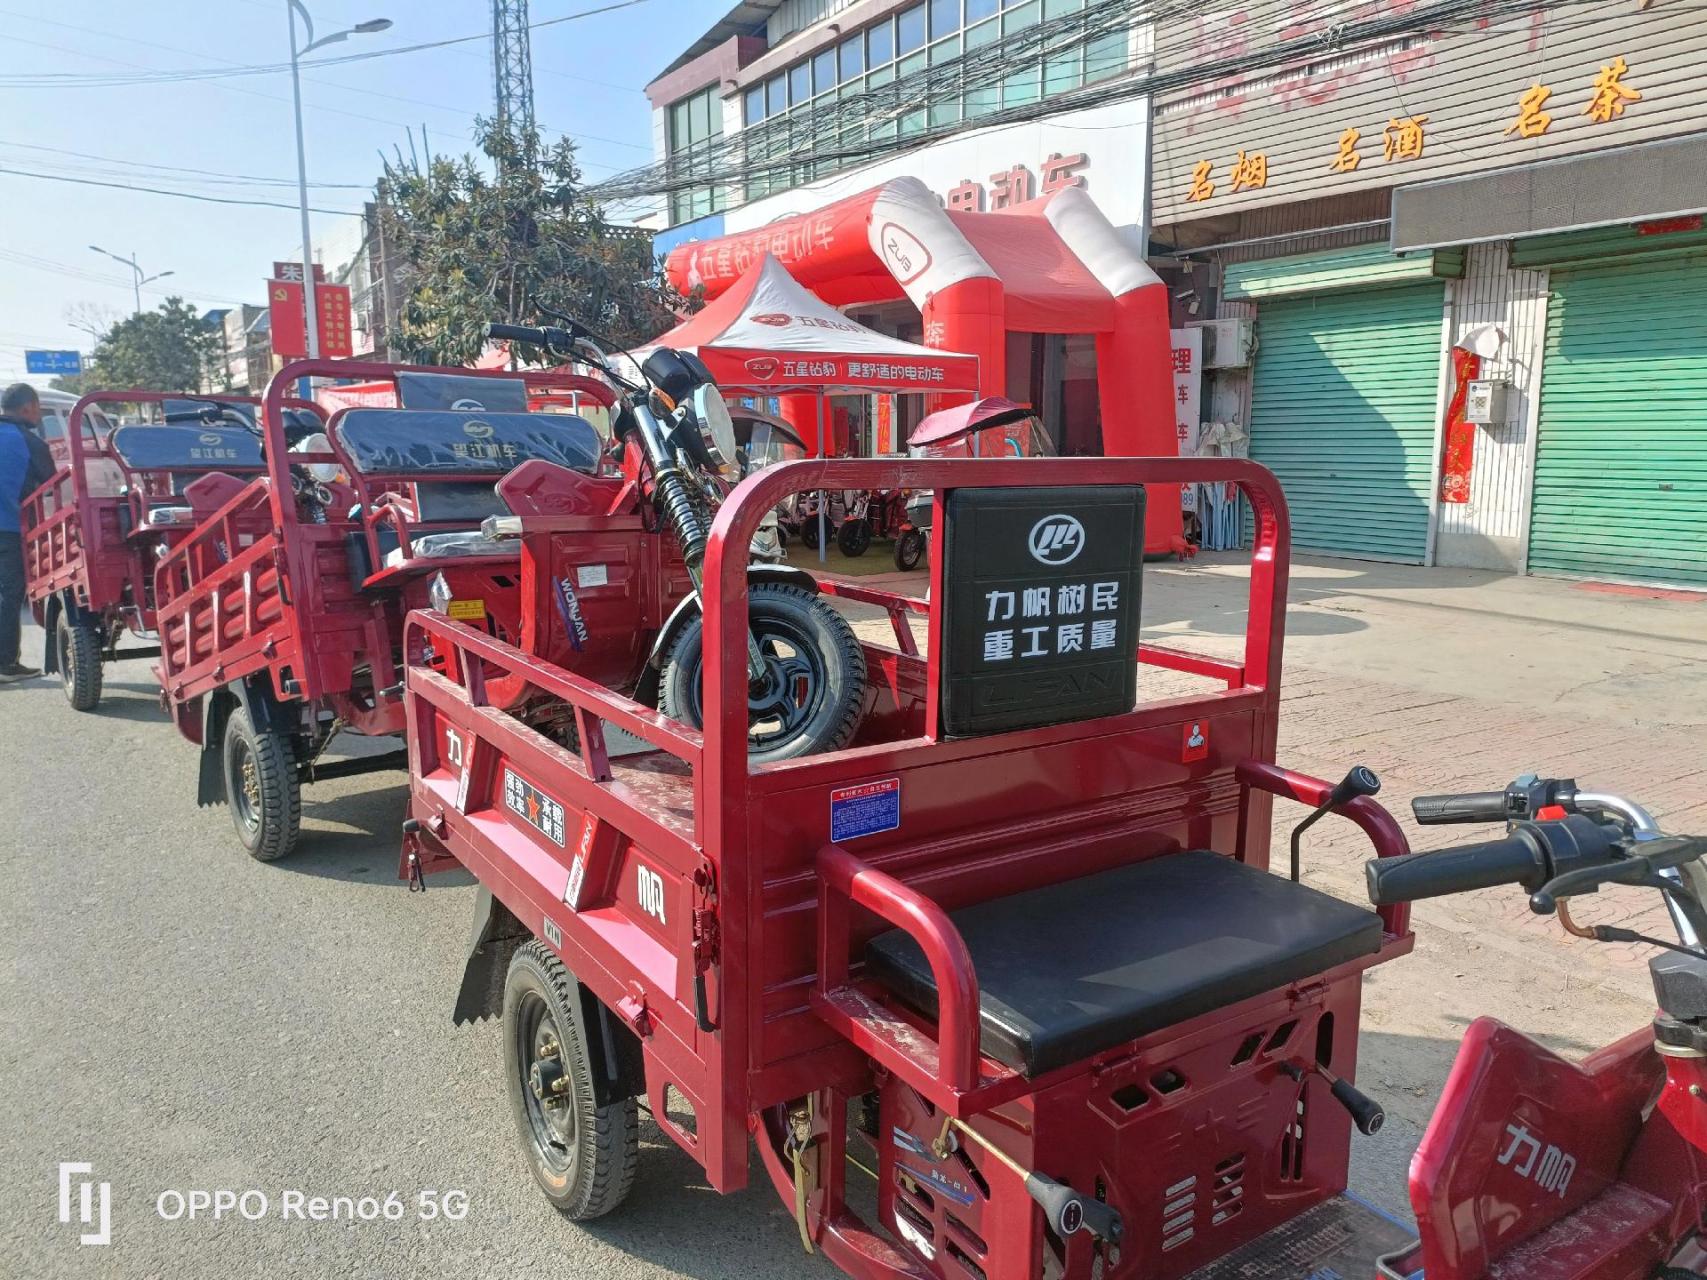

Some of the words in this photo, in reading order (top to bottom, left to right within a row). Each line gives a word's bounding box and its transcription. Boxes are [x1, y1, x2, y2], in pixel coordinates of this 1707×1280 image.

[1185, 148, 1268, 202] 名烟
[1329, 114, 1429, 172] 名酒
[1503, 56, 1643, 139] 名茶
[934, 152, 1093, 213] 电动车
[783, 361, 837, 378] 五星钻豹
[847, 361, 945, 382] 更舒适的电动车
[985, 581, 1119, 621] 力帆树民
[983, 619, 1117, 662] 重工质量
[545, 922, 561, 946] VIN
[1497, 1123, 1577, 1200] 力帆
